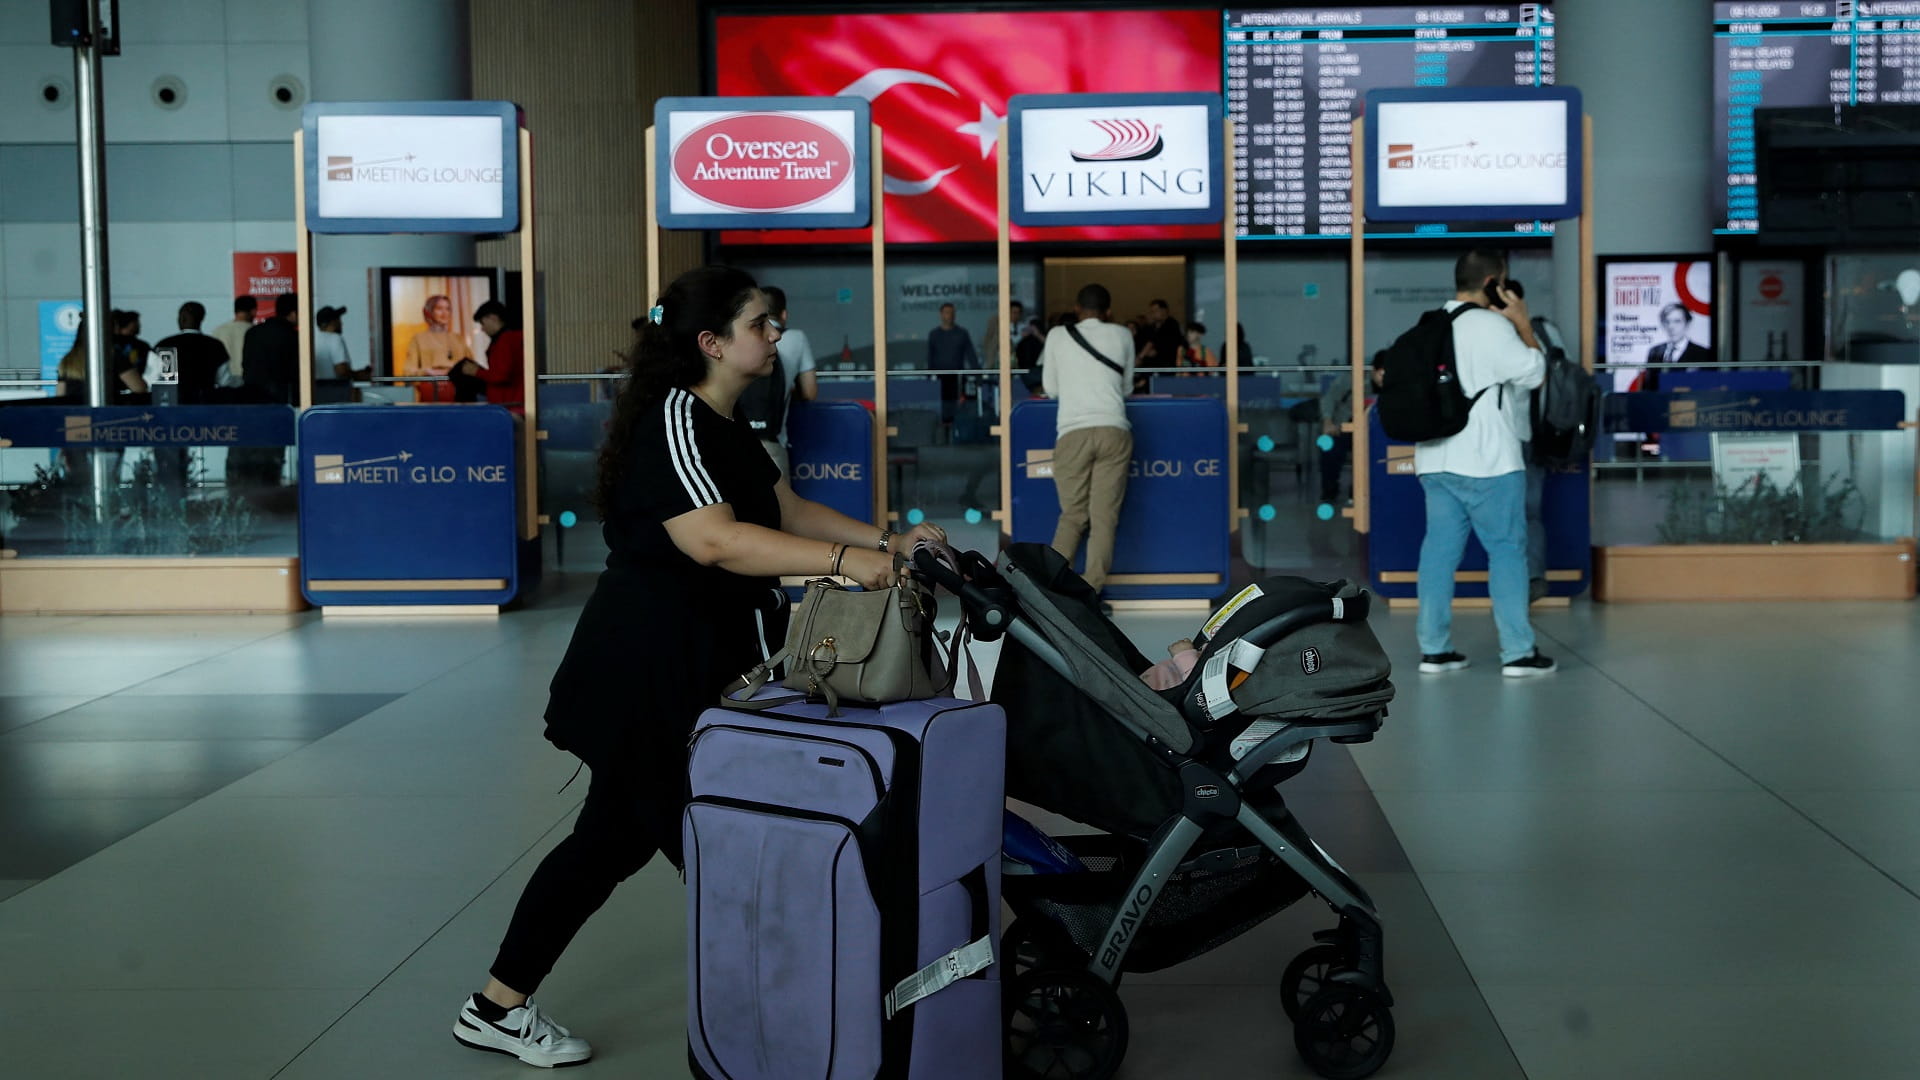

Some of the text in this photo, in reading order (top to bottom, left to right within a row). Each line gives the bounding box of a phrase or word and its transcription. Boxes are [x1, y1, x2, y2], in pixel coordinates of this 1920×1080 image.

[1241, 13, 1314, 25] INTERNATIONAL
[1316, 12, 1362, 24] ARRIVALS
[706, 133, 819, 160] Overseas
[1417, 154, 1490, 169] MEETING
[1496, 152, 1567, 169] LOUNGE
[356, 168, 428, 183] MEETING
[434, 168, 503, 183] LOUNGE
[692, 162, 780, 180] Adventure
[1030, 168, 1203, 197] VIKING
[1700, 411, 1771, 427] MEETING
[1776, 409, 1848, 426] LOUNGE
[94, 426, 166, 442] MEETING
[171, 426, 239, 442] LOUNGE
[1197, 788, 1218, 796] chicco
[1101, 884, 1152, 970] BRAVO
